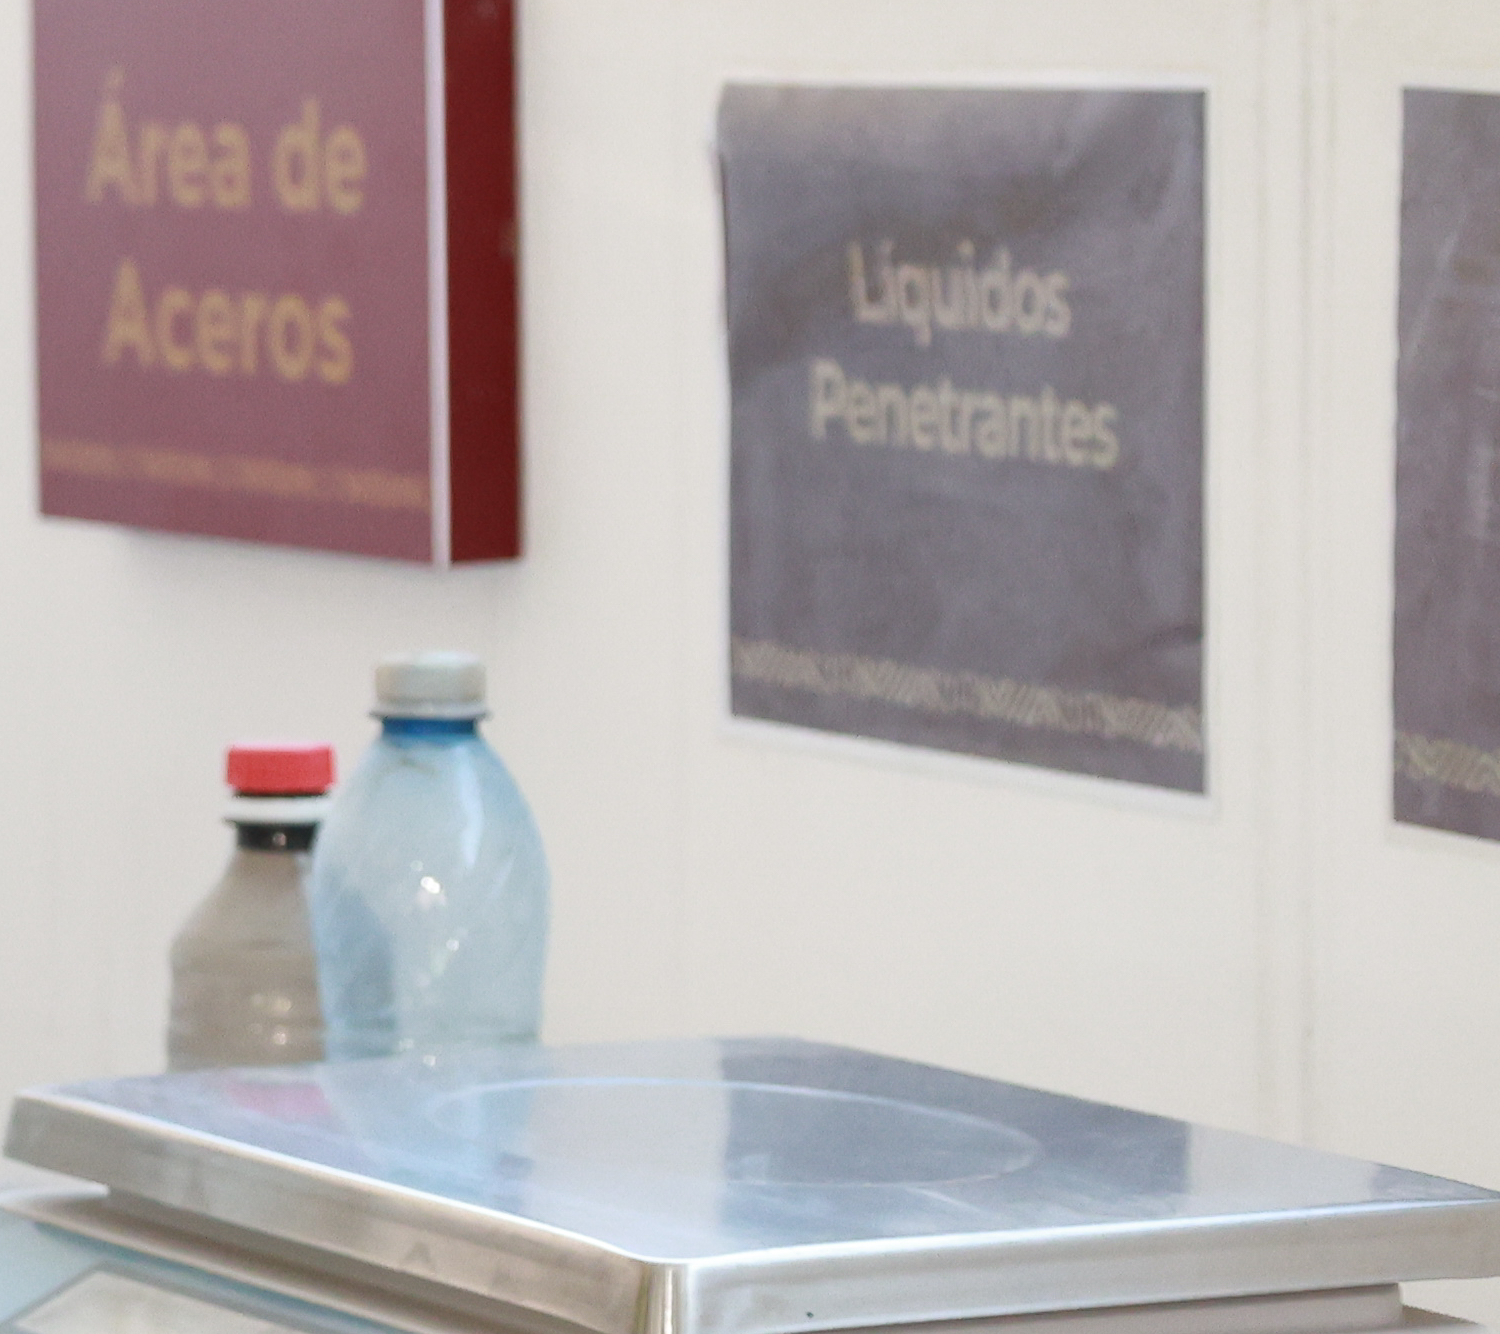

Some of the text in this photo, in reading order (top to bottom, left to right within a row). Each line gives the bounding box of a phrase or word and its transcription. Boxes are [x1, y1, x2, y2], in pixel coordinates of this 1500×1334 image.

[85, 67, 368, 216] Área de
[104, 257, 355, 387] Aceros
[846, 238, 1074, 349] Líquidos
[809, 357, 1122, 471] Penetrantes
